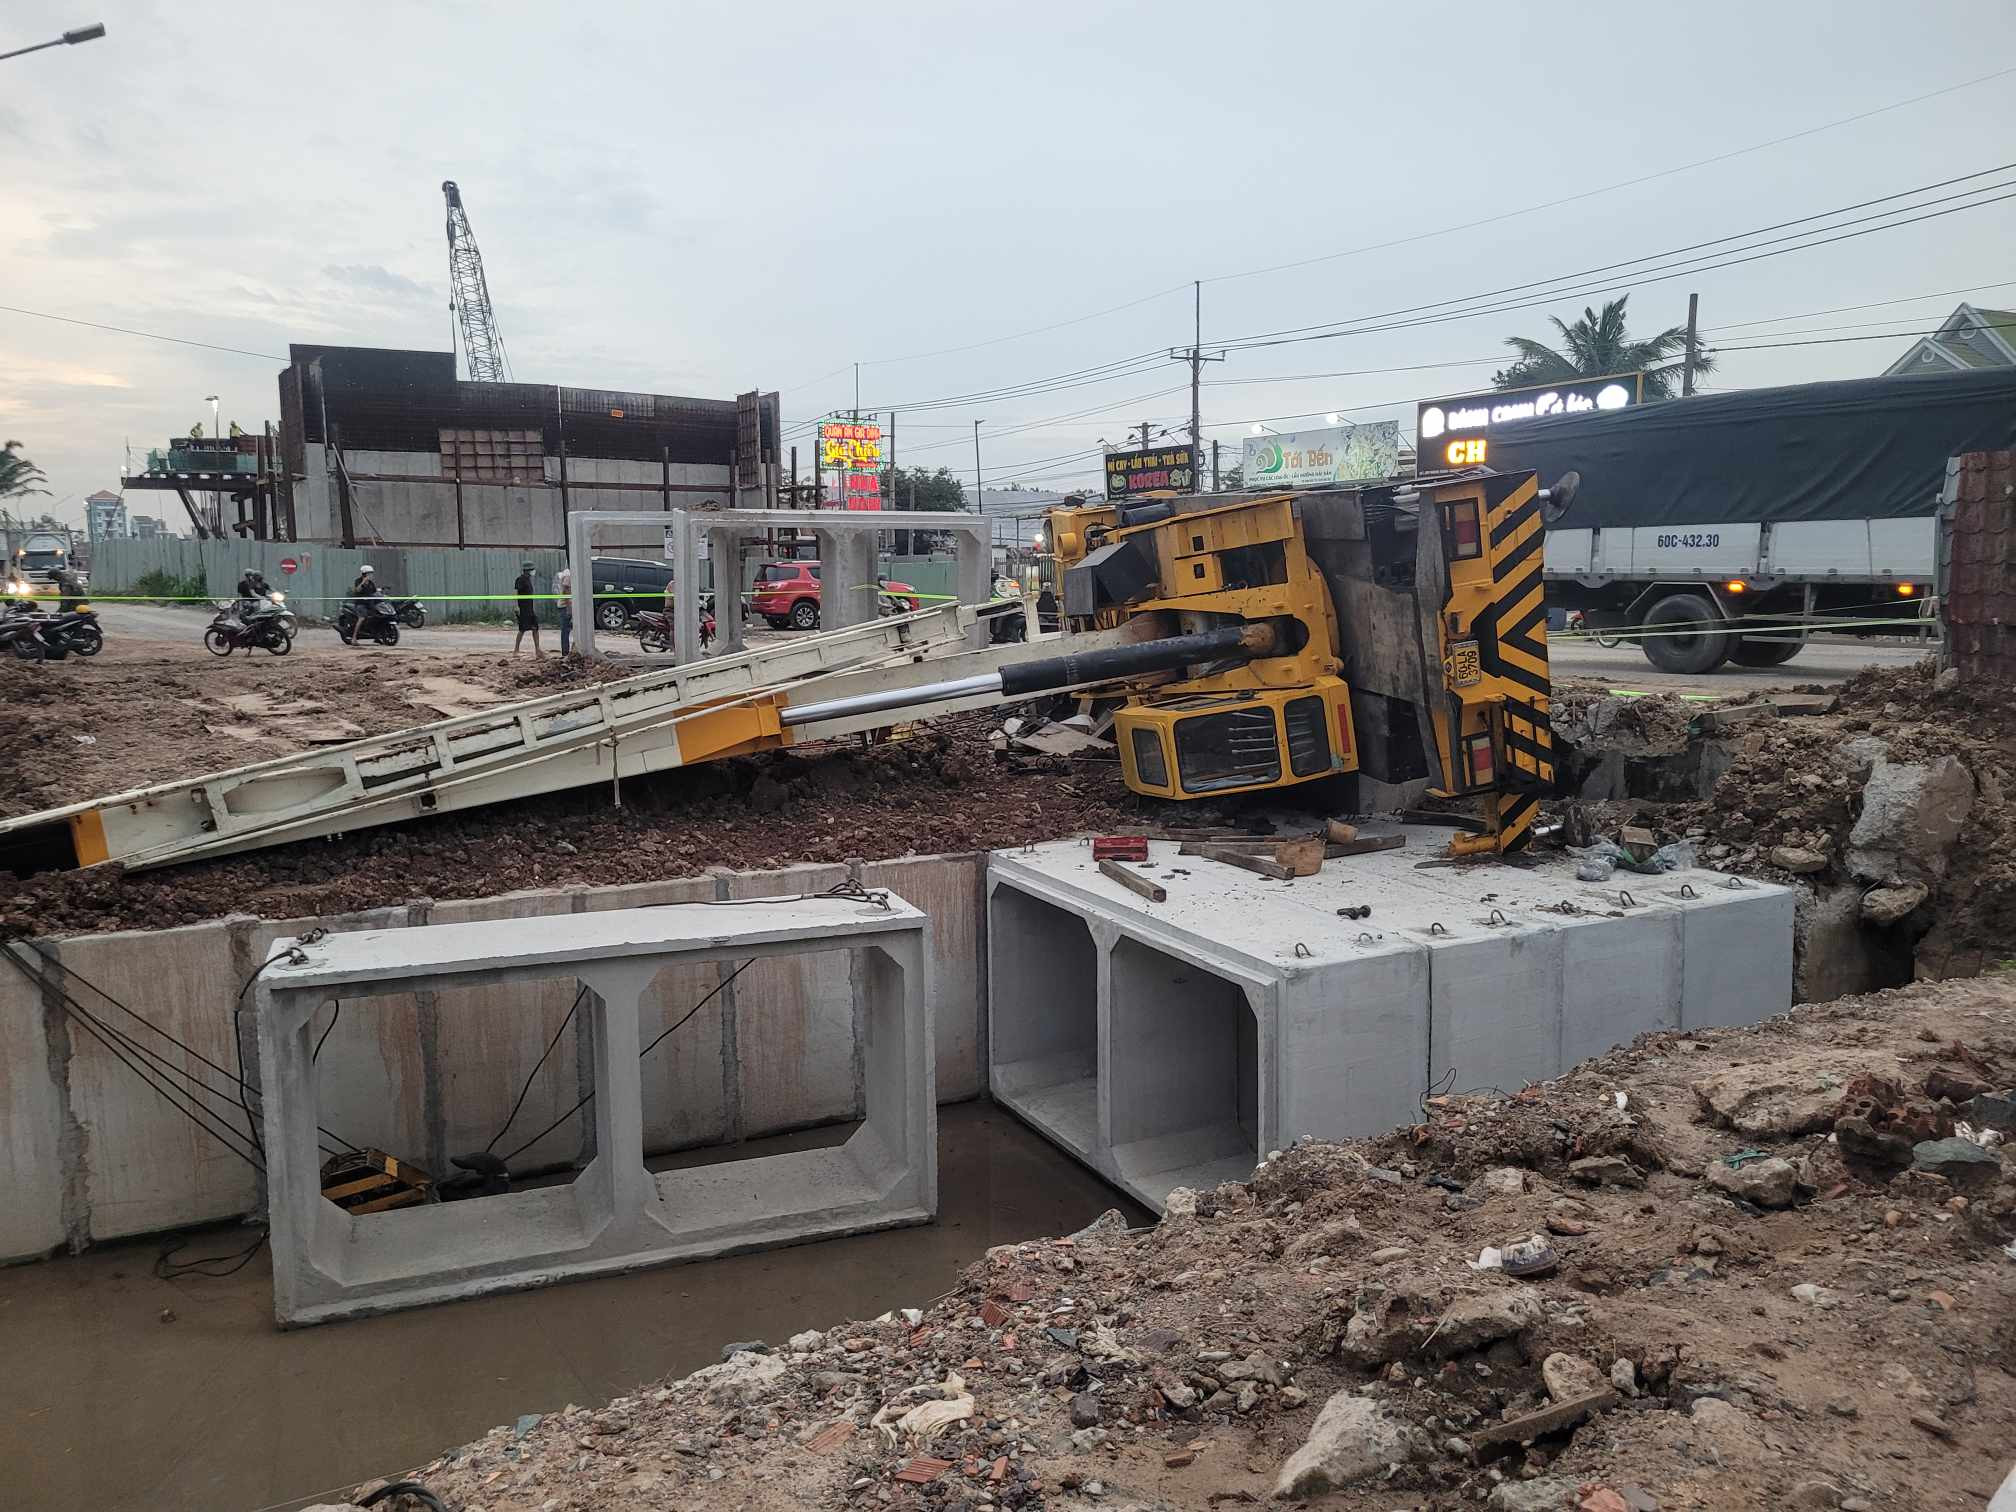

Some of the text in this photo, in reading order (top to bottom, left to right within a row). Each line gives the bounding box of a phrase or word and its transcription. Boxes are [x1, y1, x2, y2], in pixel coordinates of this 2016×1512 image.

[1116, 460, 1127, 471] CAY
[1129, 471, 1169, 489] KOREA
[1657, 534, 1720, 548] 60C-432.30
[1467, 650, 1479, 676] 3709
